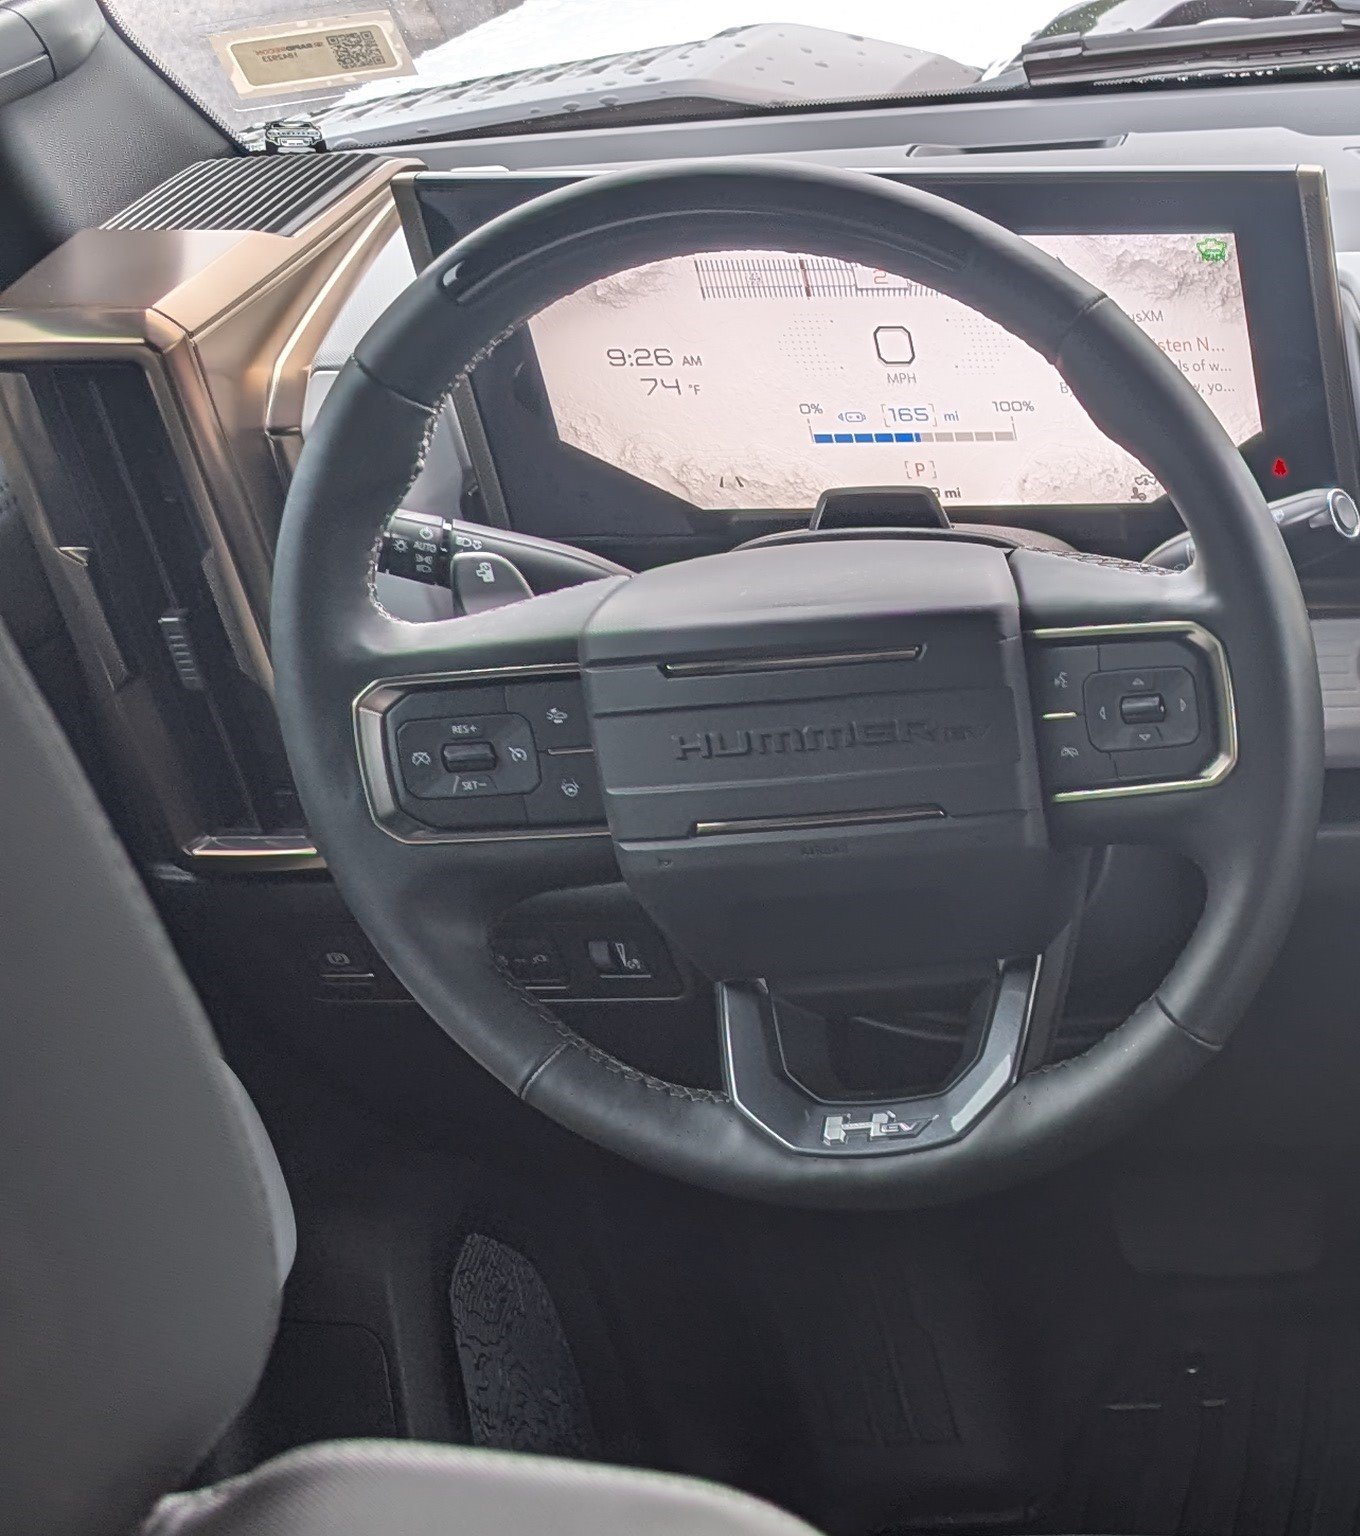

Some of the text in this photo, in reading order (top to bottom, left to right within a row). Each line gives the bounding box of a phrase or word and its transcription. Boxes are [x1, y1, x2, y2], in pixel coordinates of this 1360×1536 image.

[606, 348, 703, 367] 9:26 AM
[1192, 359, 1206, 372] of
[886, 372, 917, 384] MPH
[640, 378, 681, 396] 74
[798, 403, 824, 415] 0%
[992, 401, 1035, 413] 100%
[888, 407, 960, 422] 165 mi
[914, 462, 925, 477] P
[945, 487, 962, 498] mi
[671, 720, 936, 760] HUMMER
